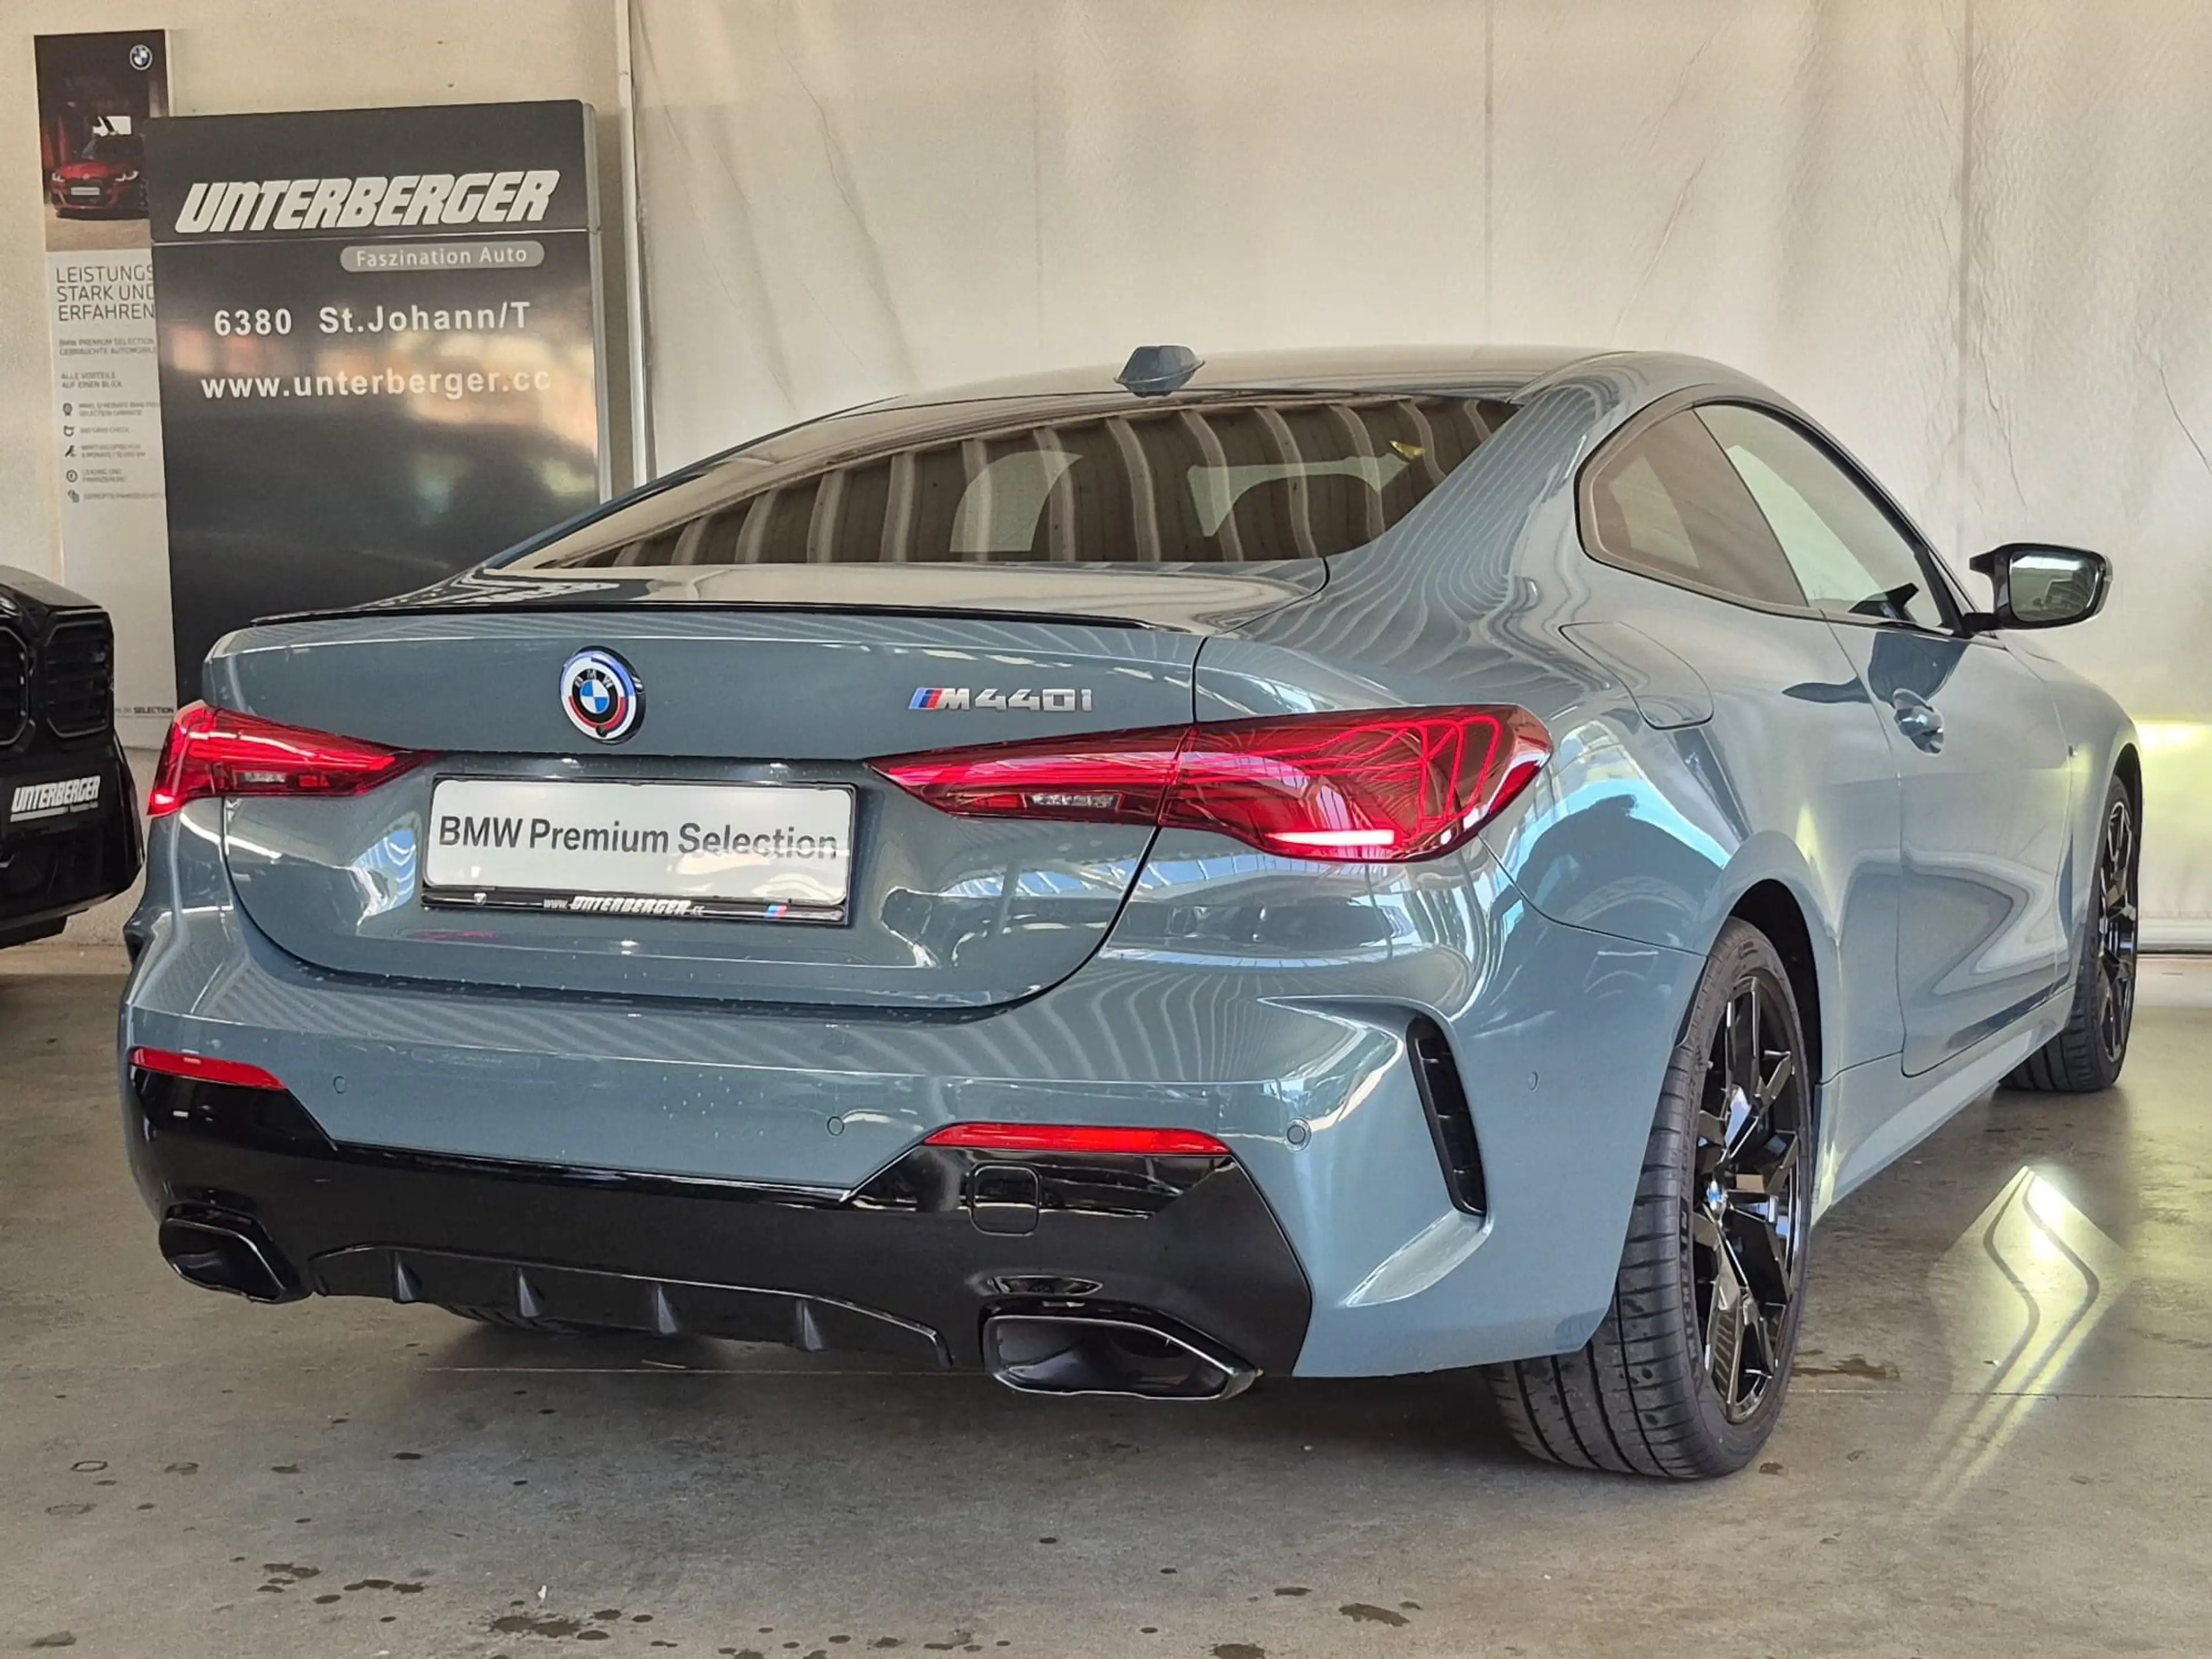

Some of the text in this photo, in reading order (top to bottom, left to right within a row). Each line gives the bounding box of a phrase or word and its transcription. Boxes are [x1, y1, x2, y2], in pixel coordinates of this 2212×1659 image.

[175, 170, 560, 233] UNTERBERGER
[356, 247, 527, 268] Faszination Auto
[57, 283, 114, 302] STARK
[58, 303, 155, 321] ERFAHREN
[214, 301, 531, 336] 6380 St.Johann/T
[201, 368, 551, 400] www.unterberger.cc
[11, 775, 101, 813] UNTERBERGER
[438, 815, 838, 860] BMW Premium Selection
